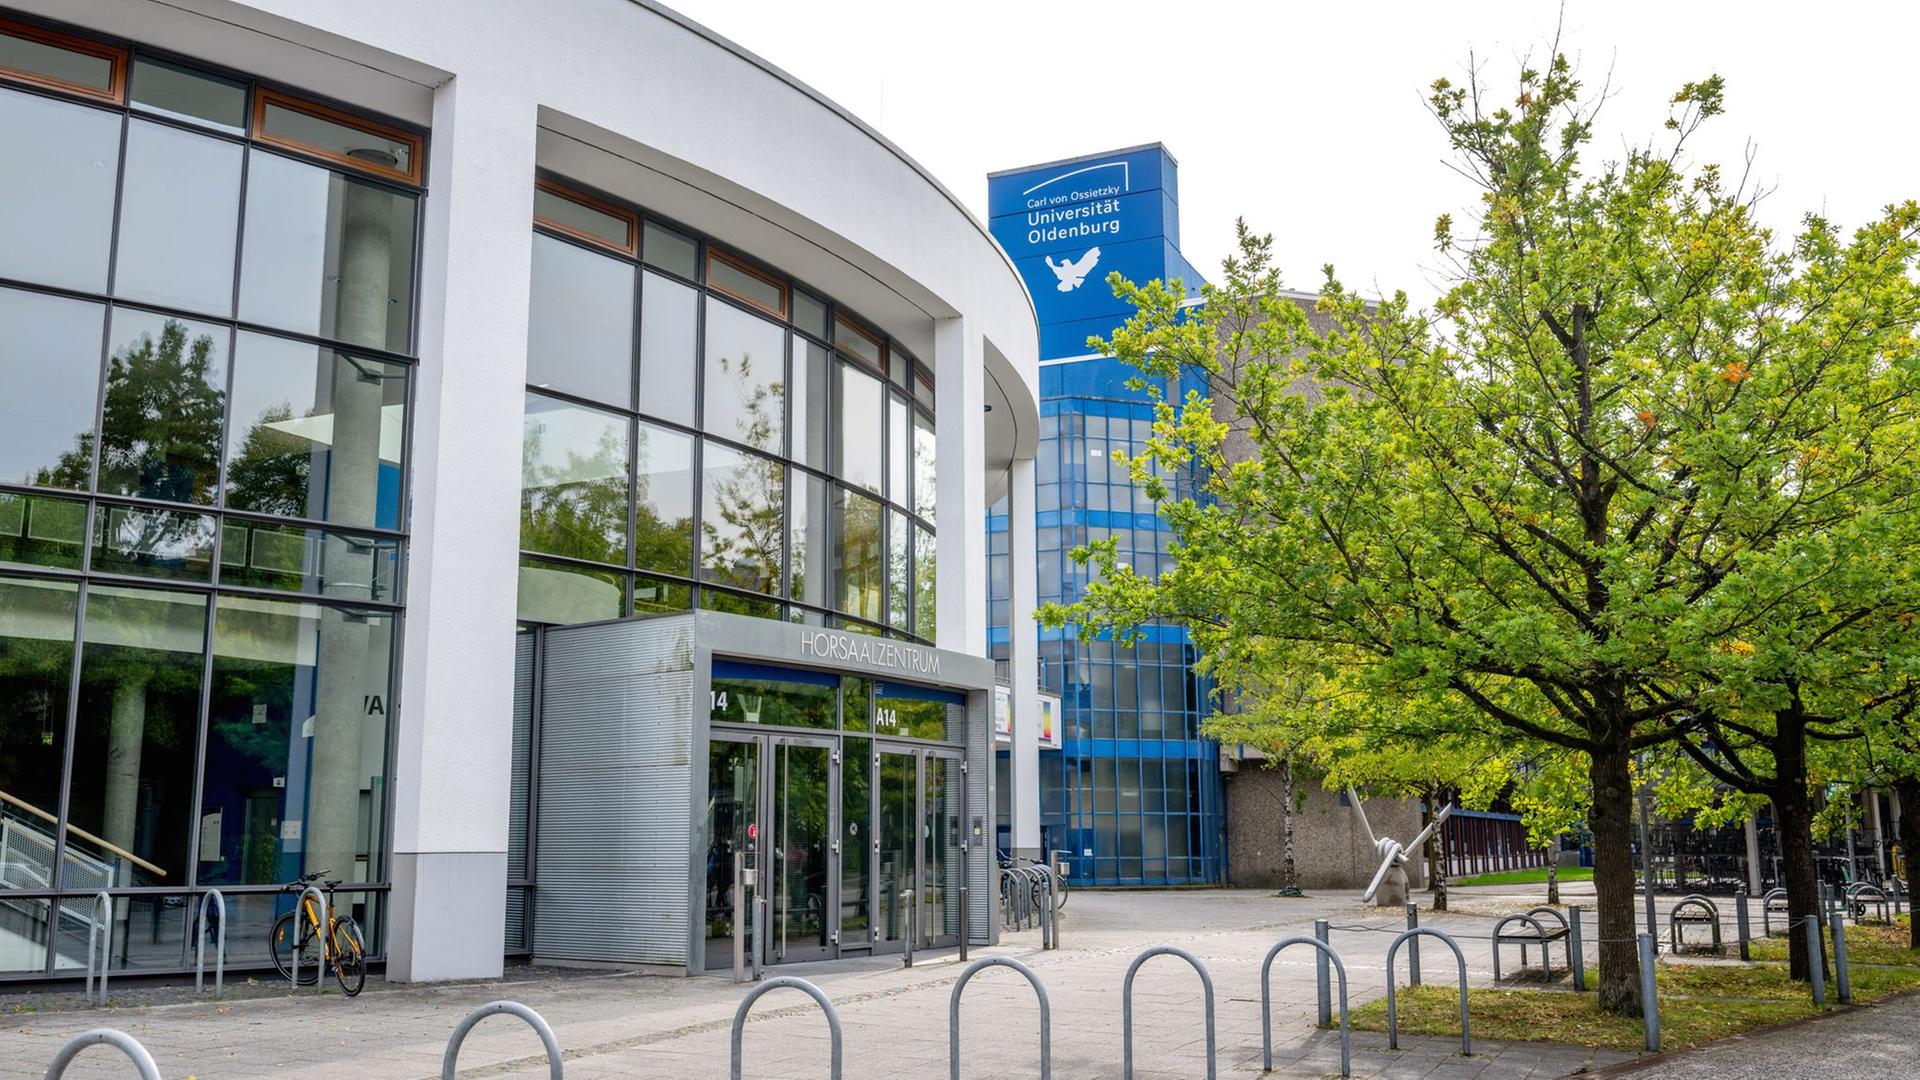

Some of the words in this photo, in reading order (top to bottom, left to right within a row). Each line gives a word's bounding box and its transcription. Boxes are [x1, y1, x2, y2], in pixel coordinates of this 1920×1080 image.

[1027, 197, 1047, 209] Carl
[1049, 195, 1068, 205] von
[1070, 185, 1120, 201] Ossietzky
[1028, 199, 1120, 226] Universität
[1028, 219, 1120, 244] Oldenburg
[876, 707, 897, 727] A14
